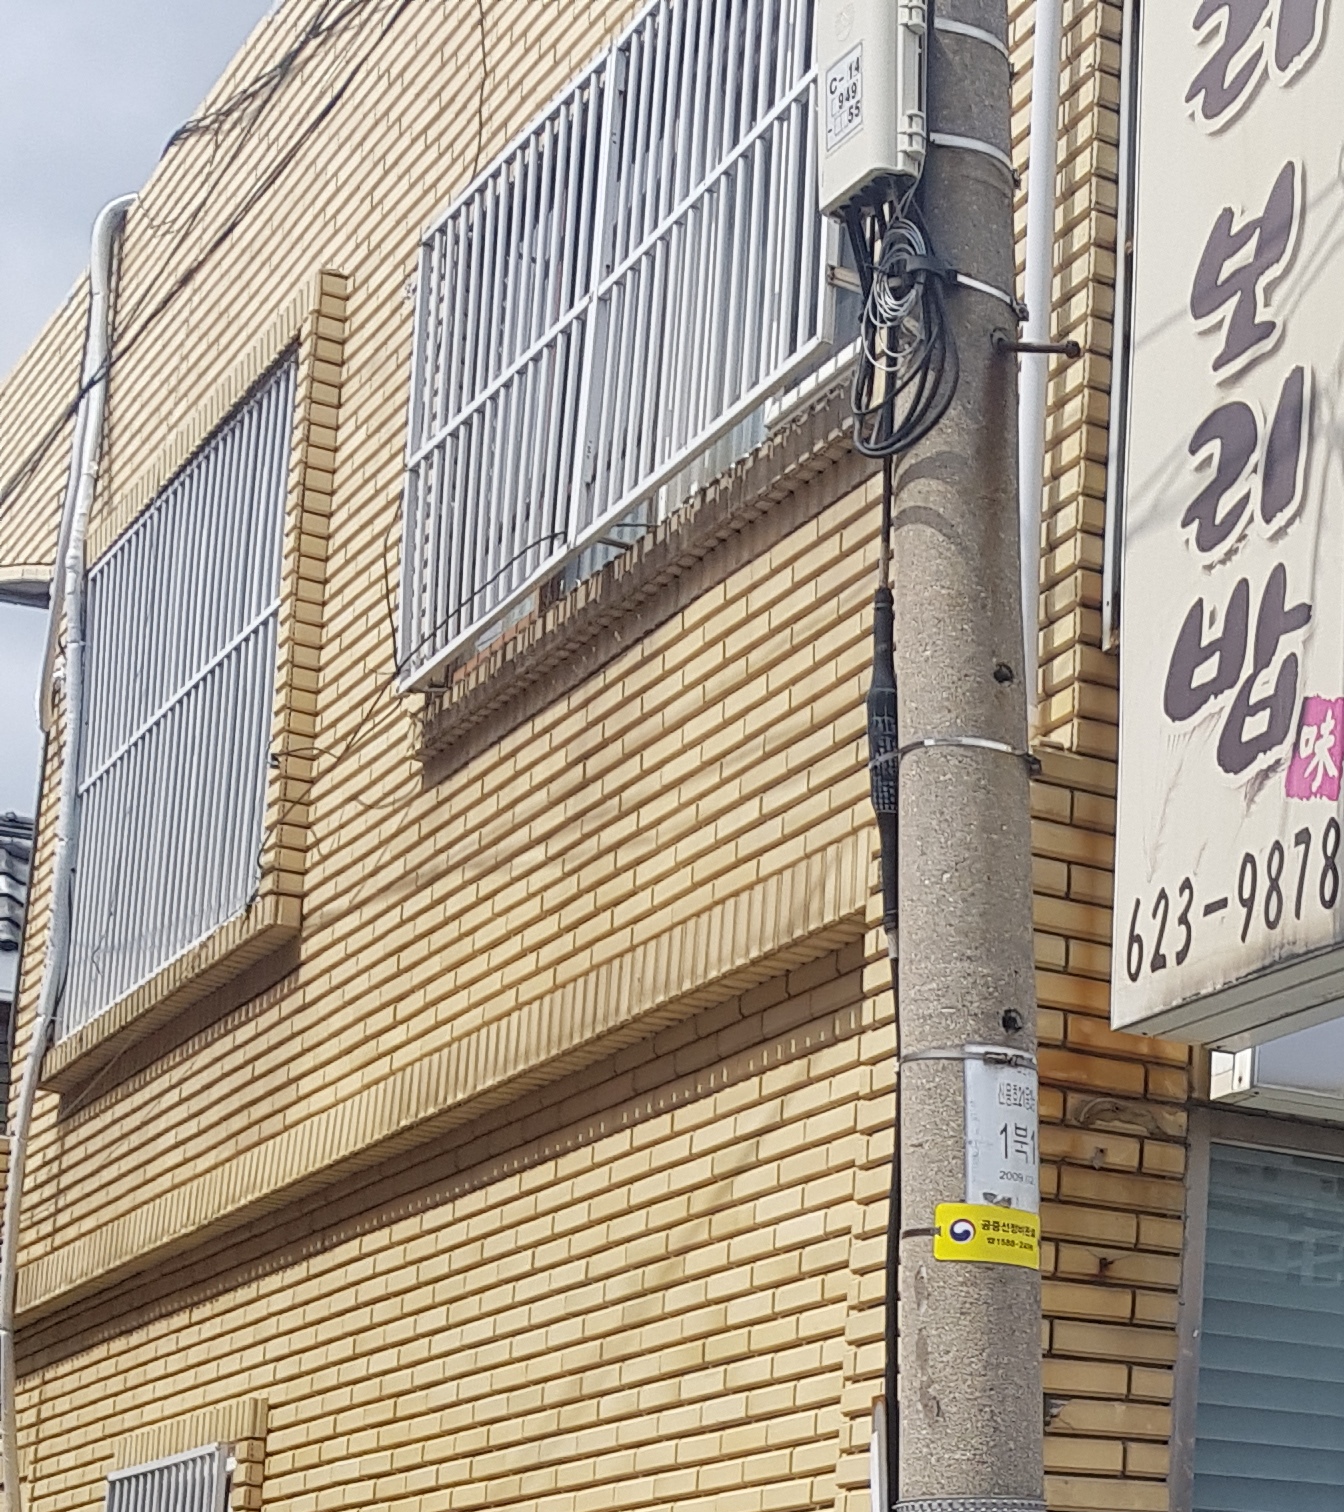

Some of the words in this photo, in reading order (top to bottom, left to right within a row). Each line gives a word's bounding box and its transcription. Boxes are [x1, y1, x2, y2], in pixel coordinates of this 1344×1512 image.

[838, 82, 857, 109] 949
[1163, 160, 1312, 774] 보리밥
[1126, 817, 1341, 983] 623-9878
